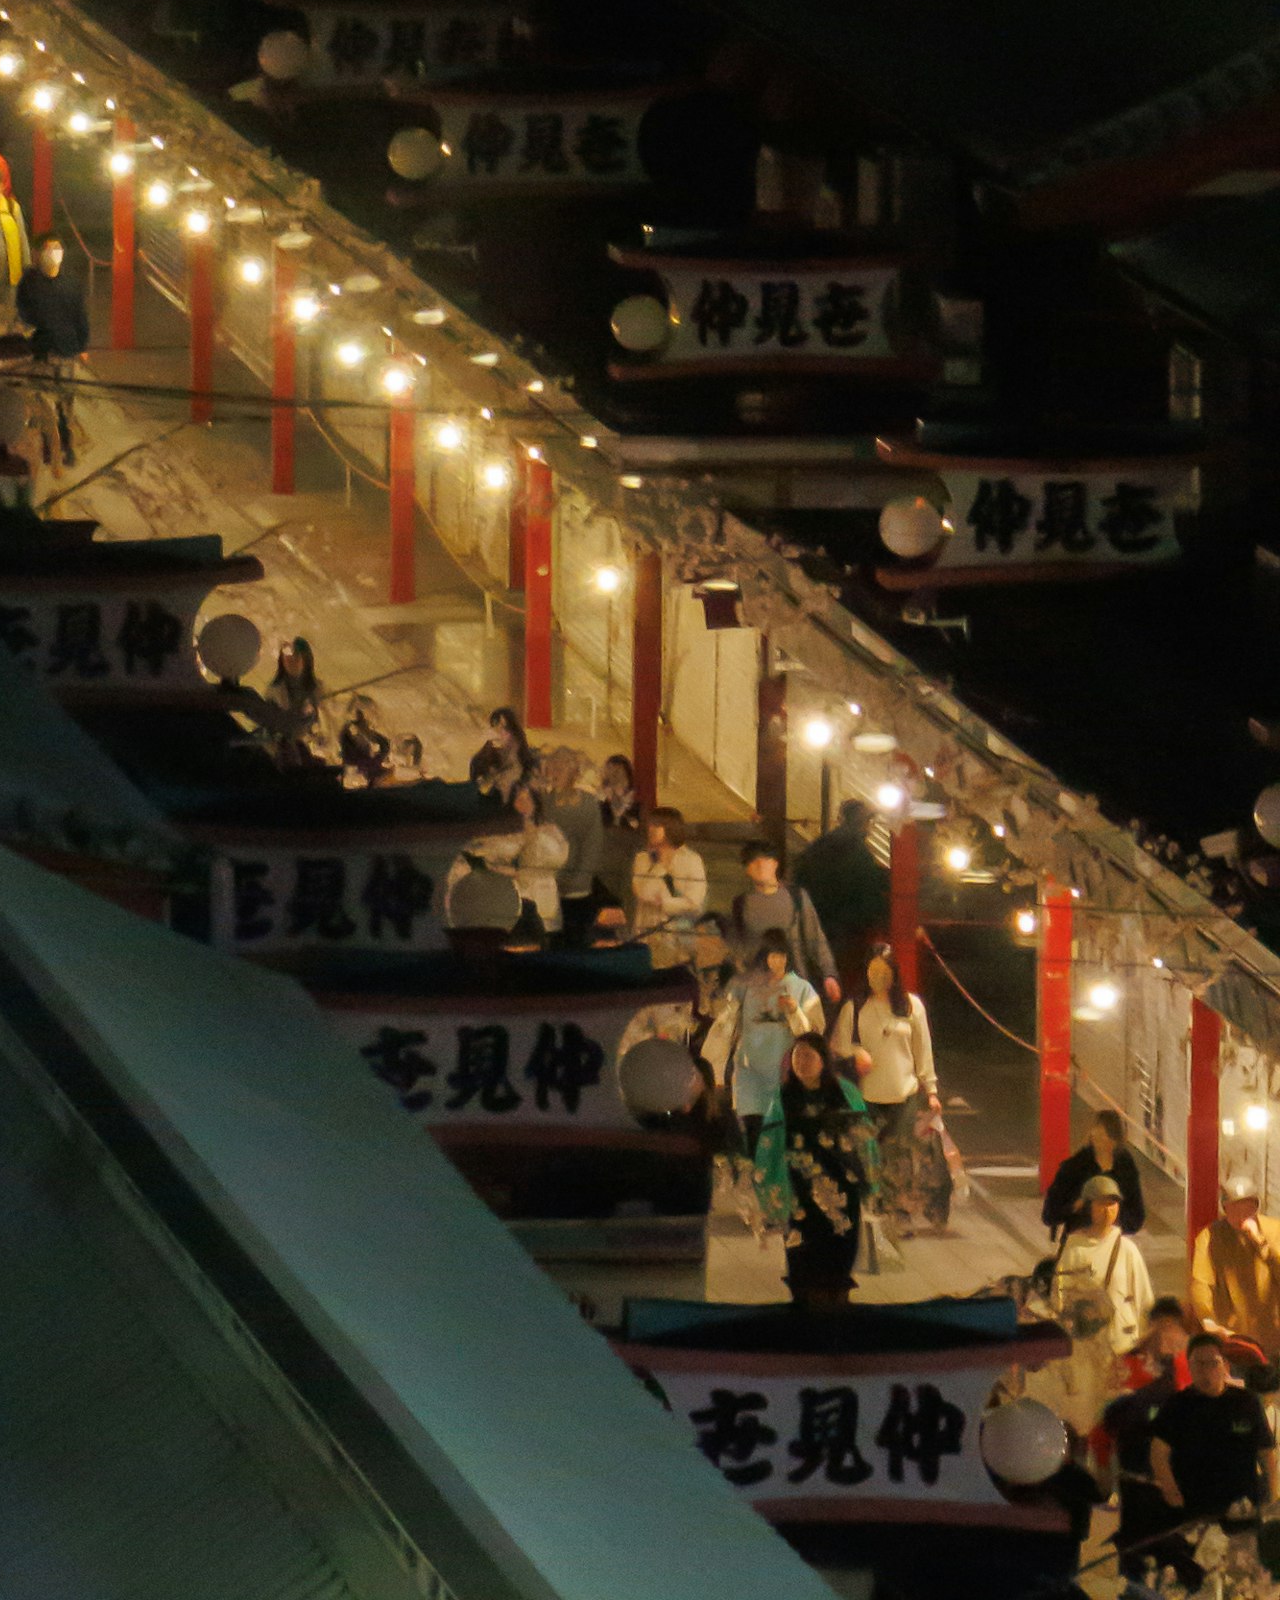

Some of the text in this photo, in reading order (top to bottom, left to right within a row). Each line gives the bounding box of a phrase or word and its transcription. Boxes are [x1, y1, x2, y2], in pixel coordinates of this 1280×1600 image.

[690, 277, 870, 349] 仲見世
[966, 476, 1165, 555] 仲見世
